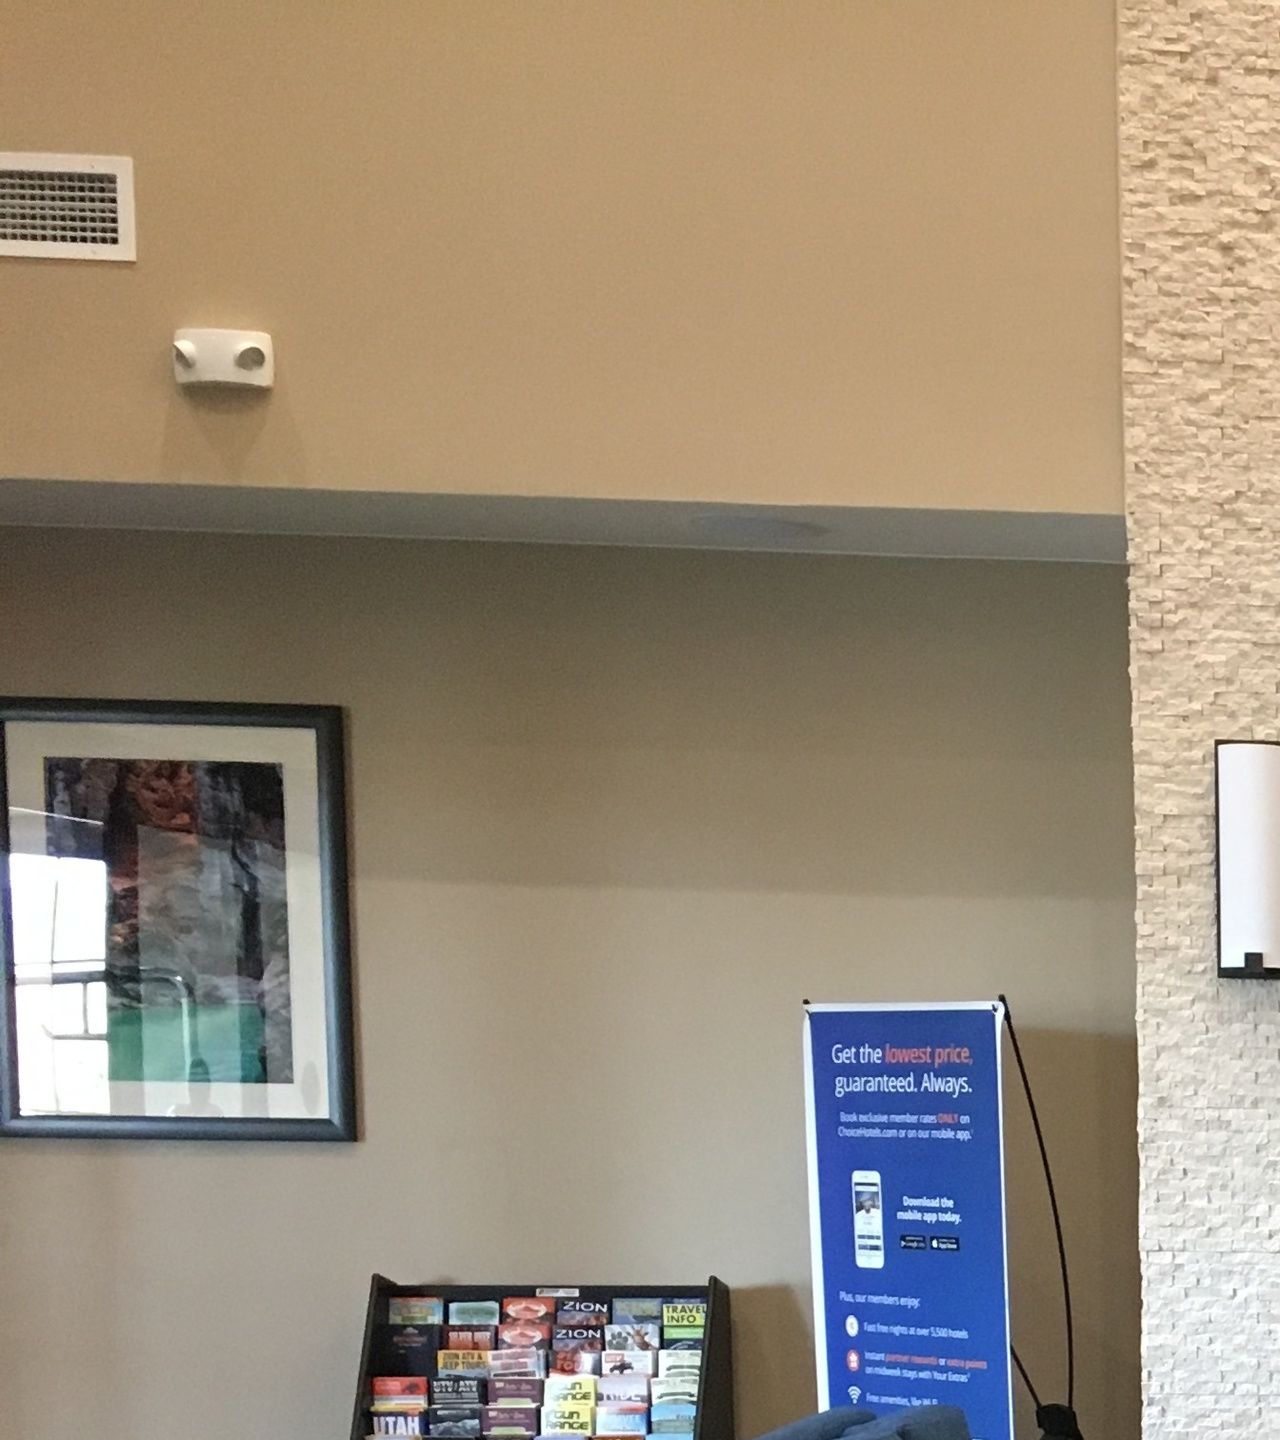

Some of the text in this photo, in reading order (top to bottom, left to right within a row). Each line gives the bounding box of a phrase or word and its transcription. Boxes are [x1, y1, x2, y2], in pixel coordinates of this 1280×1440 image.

[831, 1044, 857, 1064] Get
[859, 1043, 882, 1064] the
[885, 1043, 932, 1064] lowest
[835, 1072, 973, 1099] guaranteed. Always.
[903, 1195, 954, 1208] Download the
[897, 1209, 962, 1225] mobile app today.
[563, 1301, 608, 1313] ZION
[665, 1305, 707, 1314] TRAVEL
[666, 1315, 697, 1324] INFO
[556, 1329, 601, 1339] ZION
[553, 1391, 591, 1400] ANGE
[373, 1416, 419, 1435] UTAH
